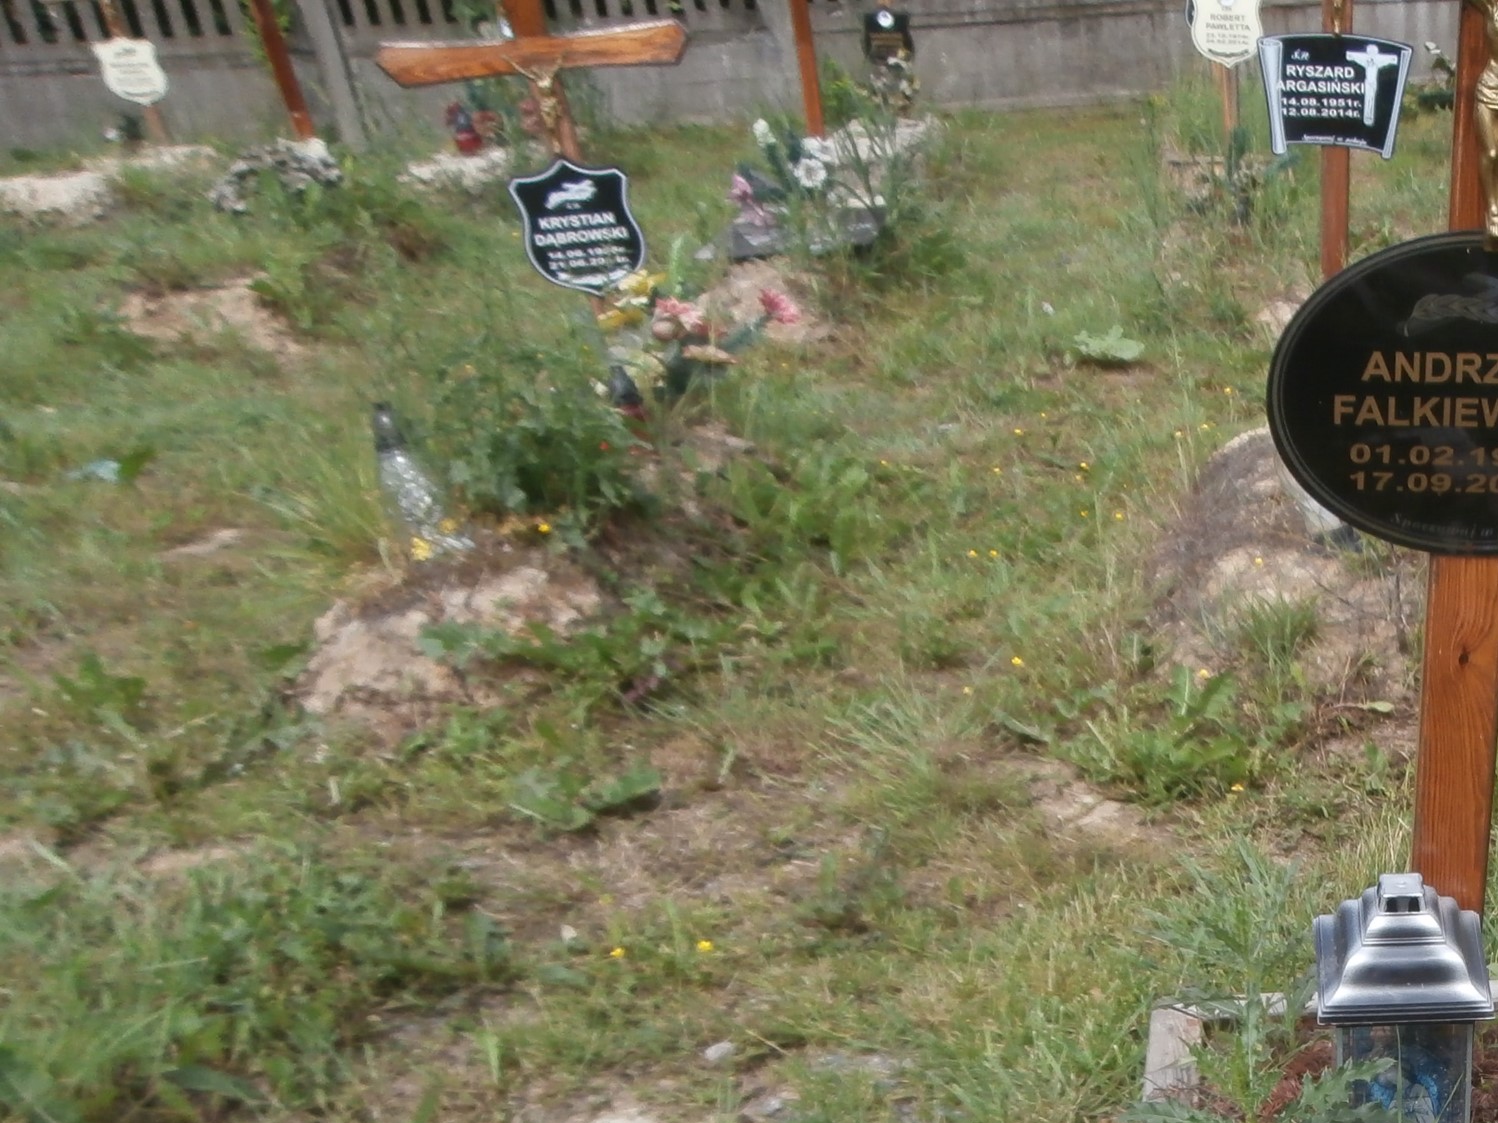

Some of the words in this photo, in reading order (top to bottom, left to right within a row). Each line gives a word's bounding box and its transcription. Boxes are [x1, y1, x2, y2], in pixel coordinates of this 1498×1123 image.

[1209, 13, 1246, 22] ROBERT
[1286, 64, 1355, 79] RYSZARD
[1276, 79, 1365, 94] ARGASIŃSKI
[1281, 97, 1362, 108] 14.08.1951r.
[1281, 107, 1361, 118] 12.08.2014r.
[537, 212, 616, 231] KRYSTIAN
[533, 226, 630, 248] DĄBROWSKI
